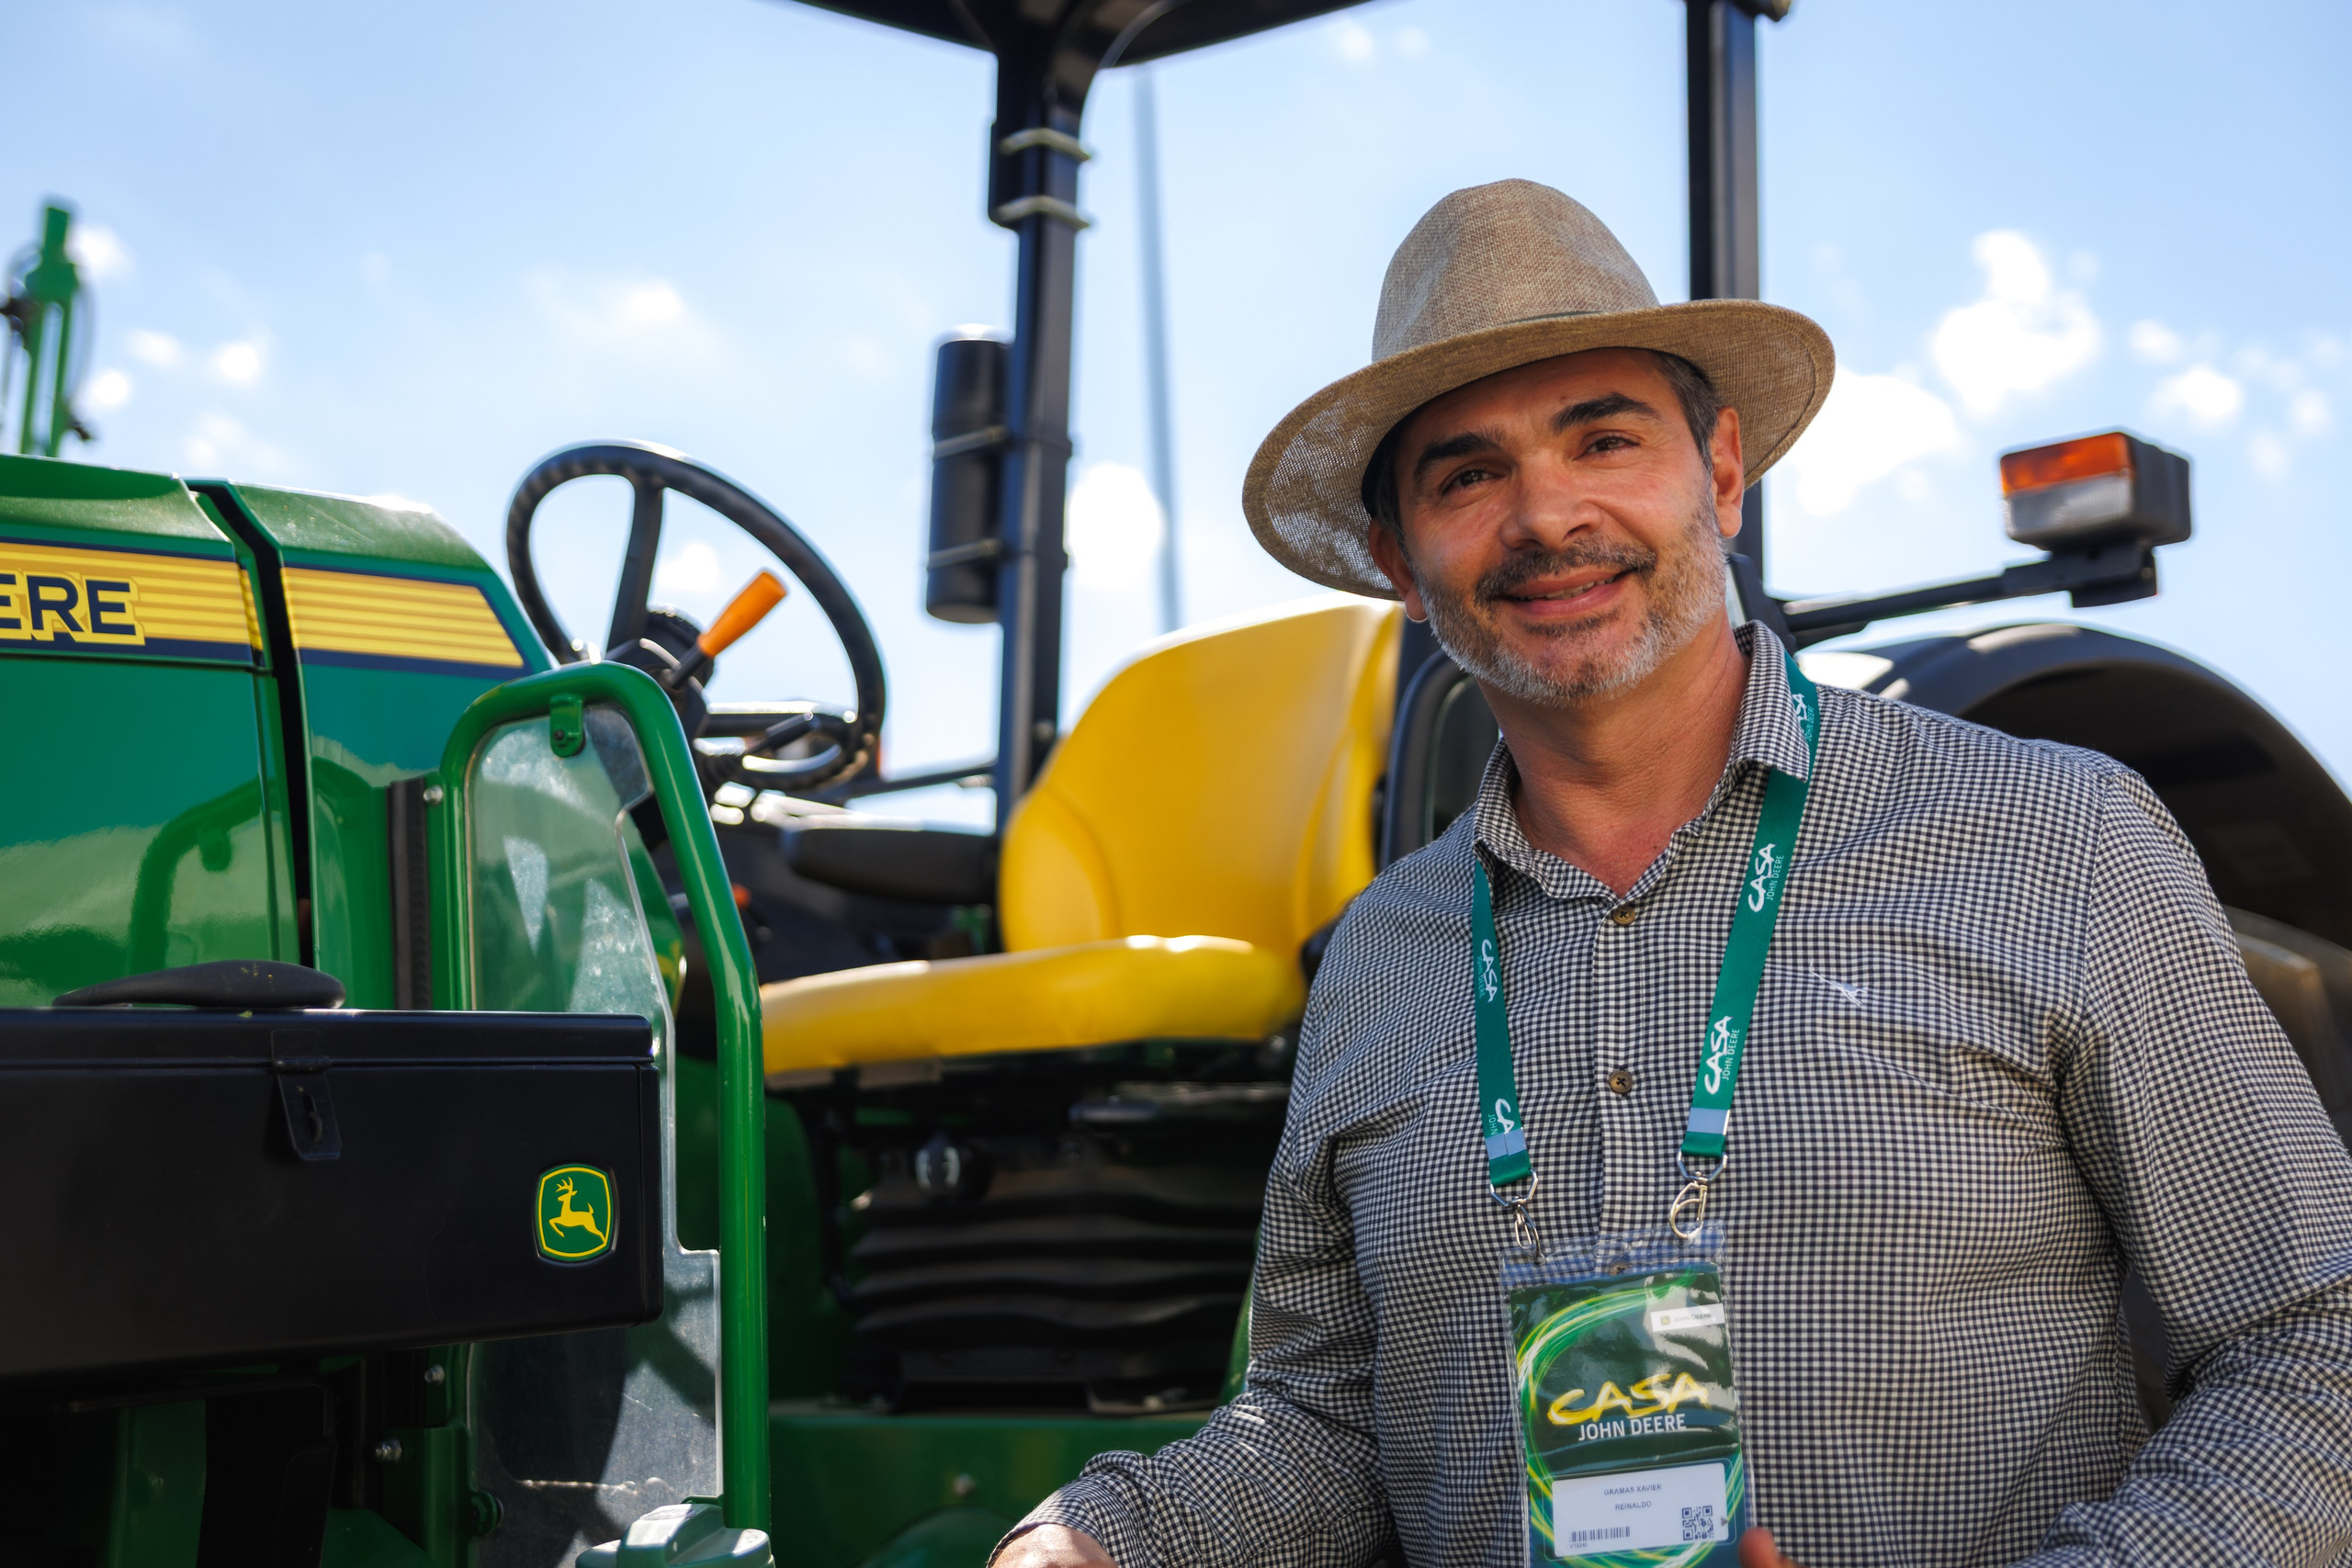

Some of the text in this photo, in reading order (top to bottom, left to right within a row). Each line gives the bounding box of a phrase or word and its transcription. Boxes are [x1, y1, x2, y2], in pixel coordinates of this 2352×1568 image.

[1747, 842, 1776, 912] CASA
[1766, 855, 1784, 900] JOHN DEERE
[1481, 939, 1498, 1003] CASA
[1704, 1015, 1734, 1095] CASA
[1722, 1029, 1740, 1080] JOHN DEERE
[1488, 1114, 1498, 1135] JOHN
[1547, 1371, 1712, 1425] CASA
[1578, 1414, 1687, 1441] JOHN DEERE
[1604, 1483, 1662, 1495] GRAMAS XAVIER
[1615, 1500, 1652, 1510] REINALDO
